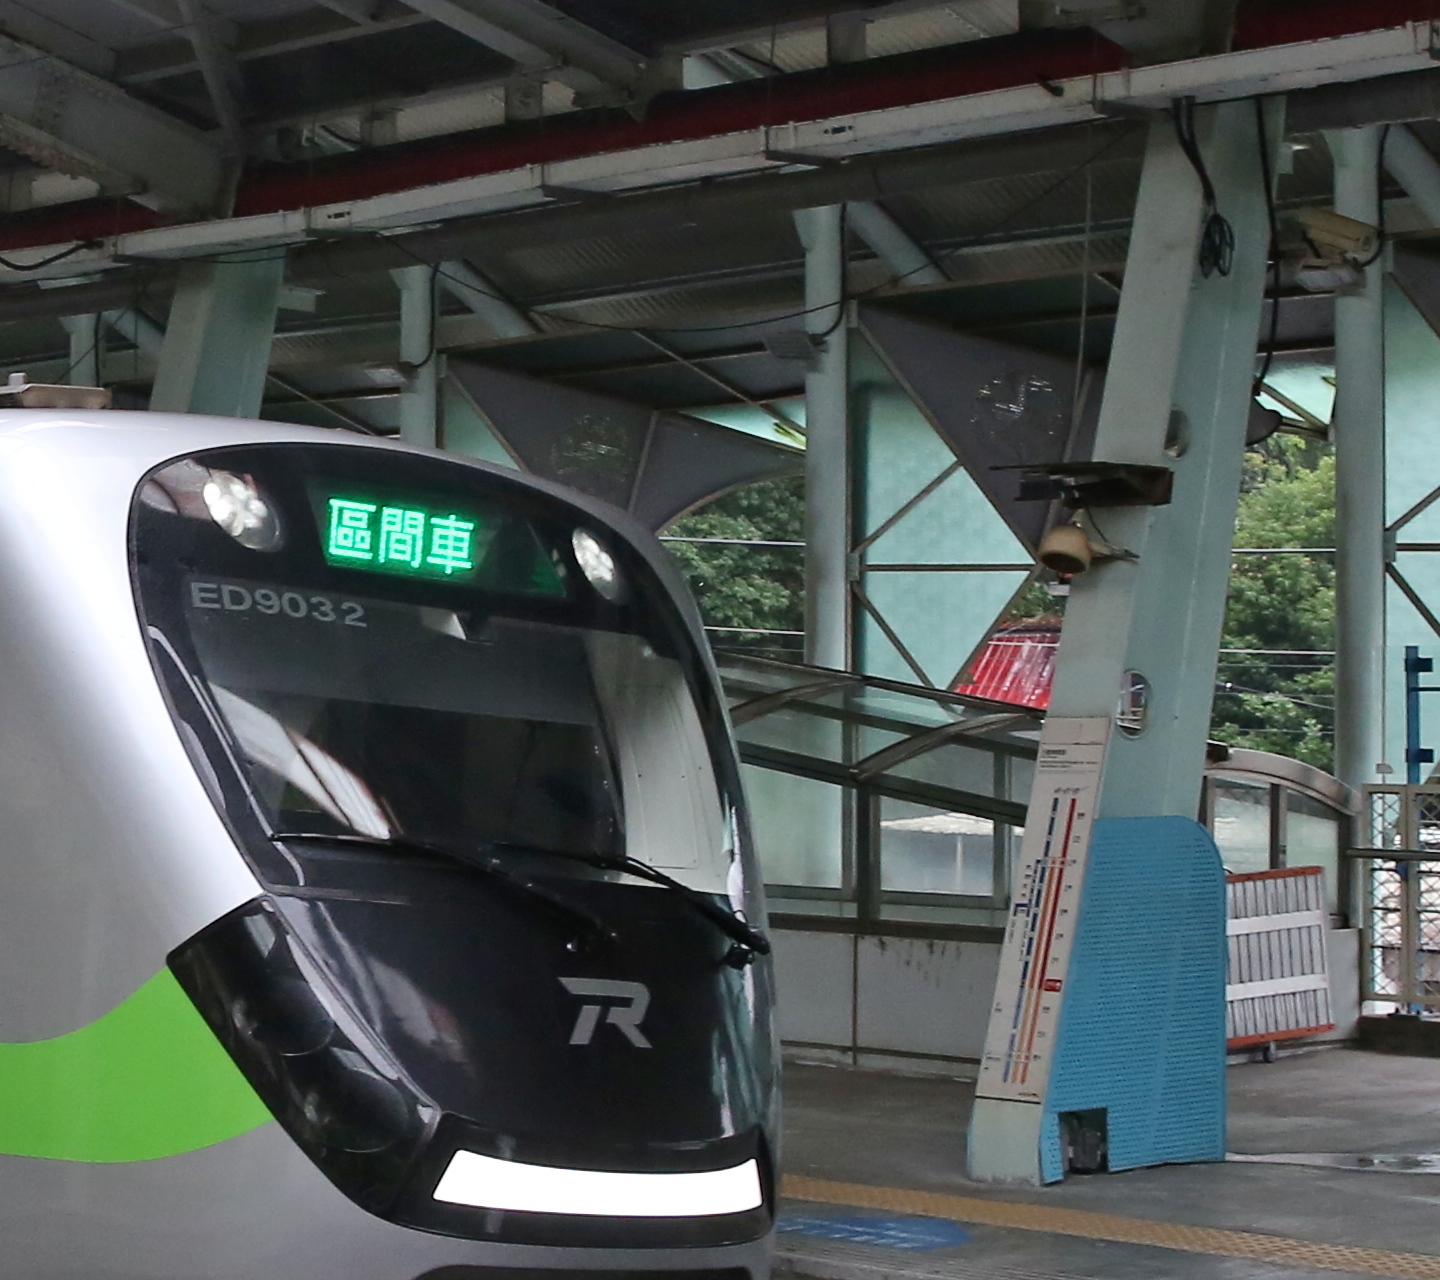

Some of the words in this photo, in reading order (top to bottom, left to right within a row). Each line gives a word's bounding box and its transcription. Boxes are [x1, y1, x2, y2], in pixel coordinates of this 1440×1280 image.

[328, 498, 475, 575] 區間車
[190, 581, 368, 628] ED9032
